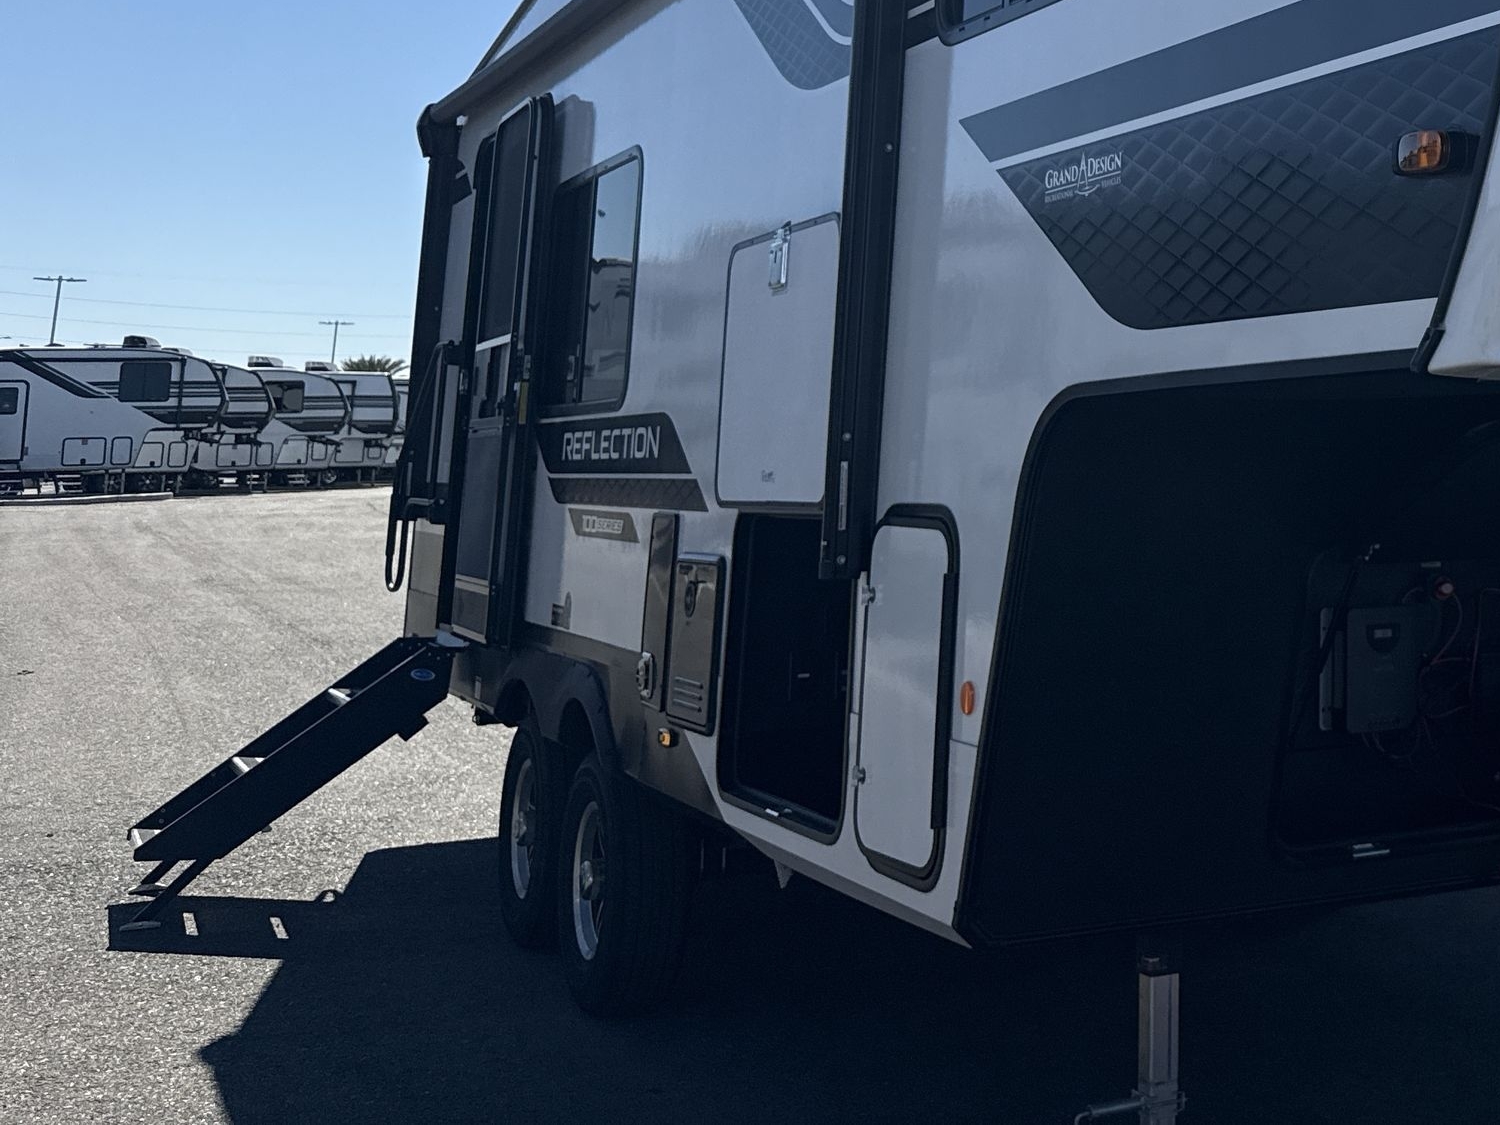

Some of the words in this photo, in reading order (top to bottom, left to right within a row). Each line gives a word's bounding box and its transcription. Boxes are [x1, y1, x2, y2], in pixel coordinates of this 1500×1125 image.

[1045, 165, 1078, 188] GRAND
[1087, 151, 1122, 177] DESIGN
[562, 426, 660, 460] REFLECTION
[598, 519, 623, 533] SERIES
